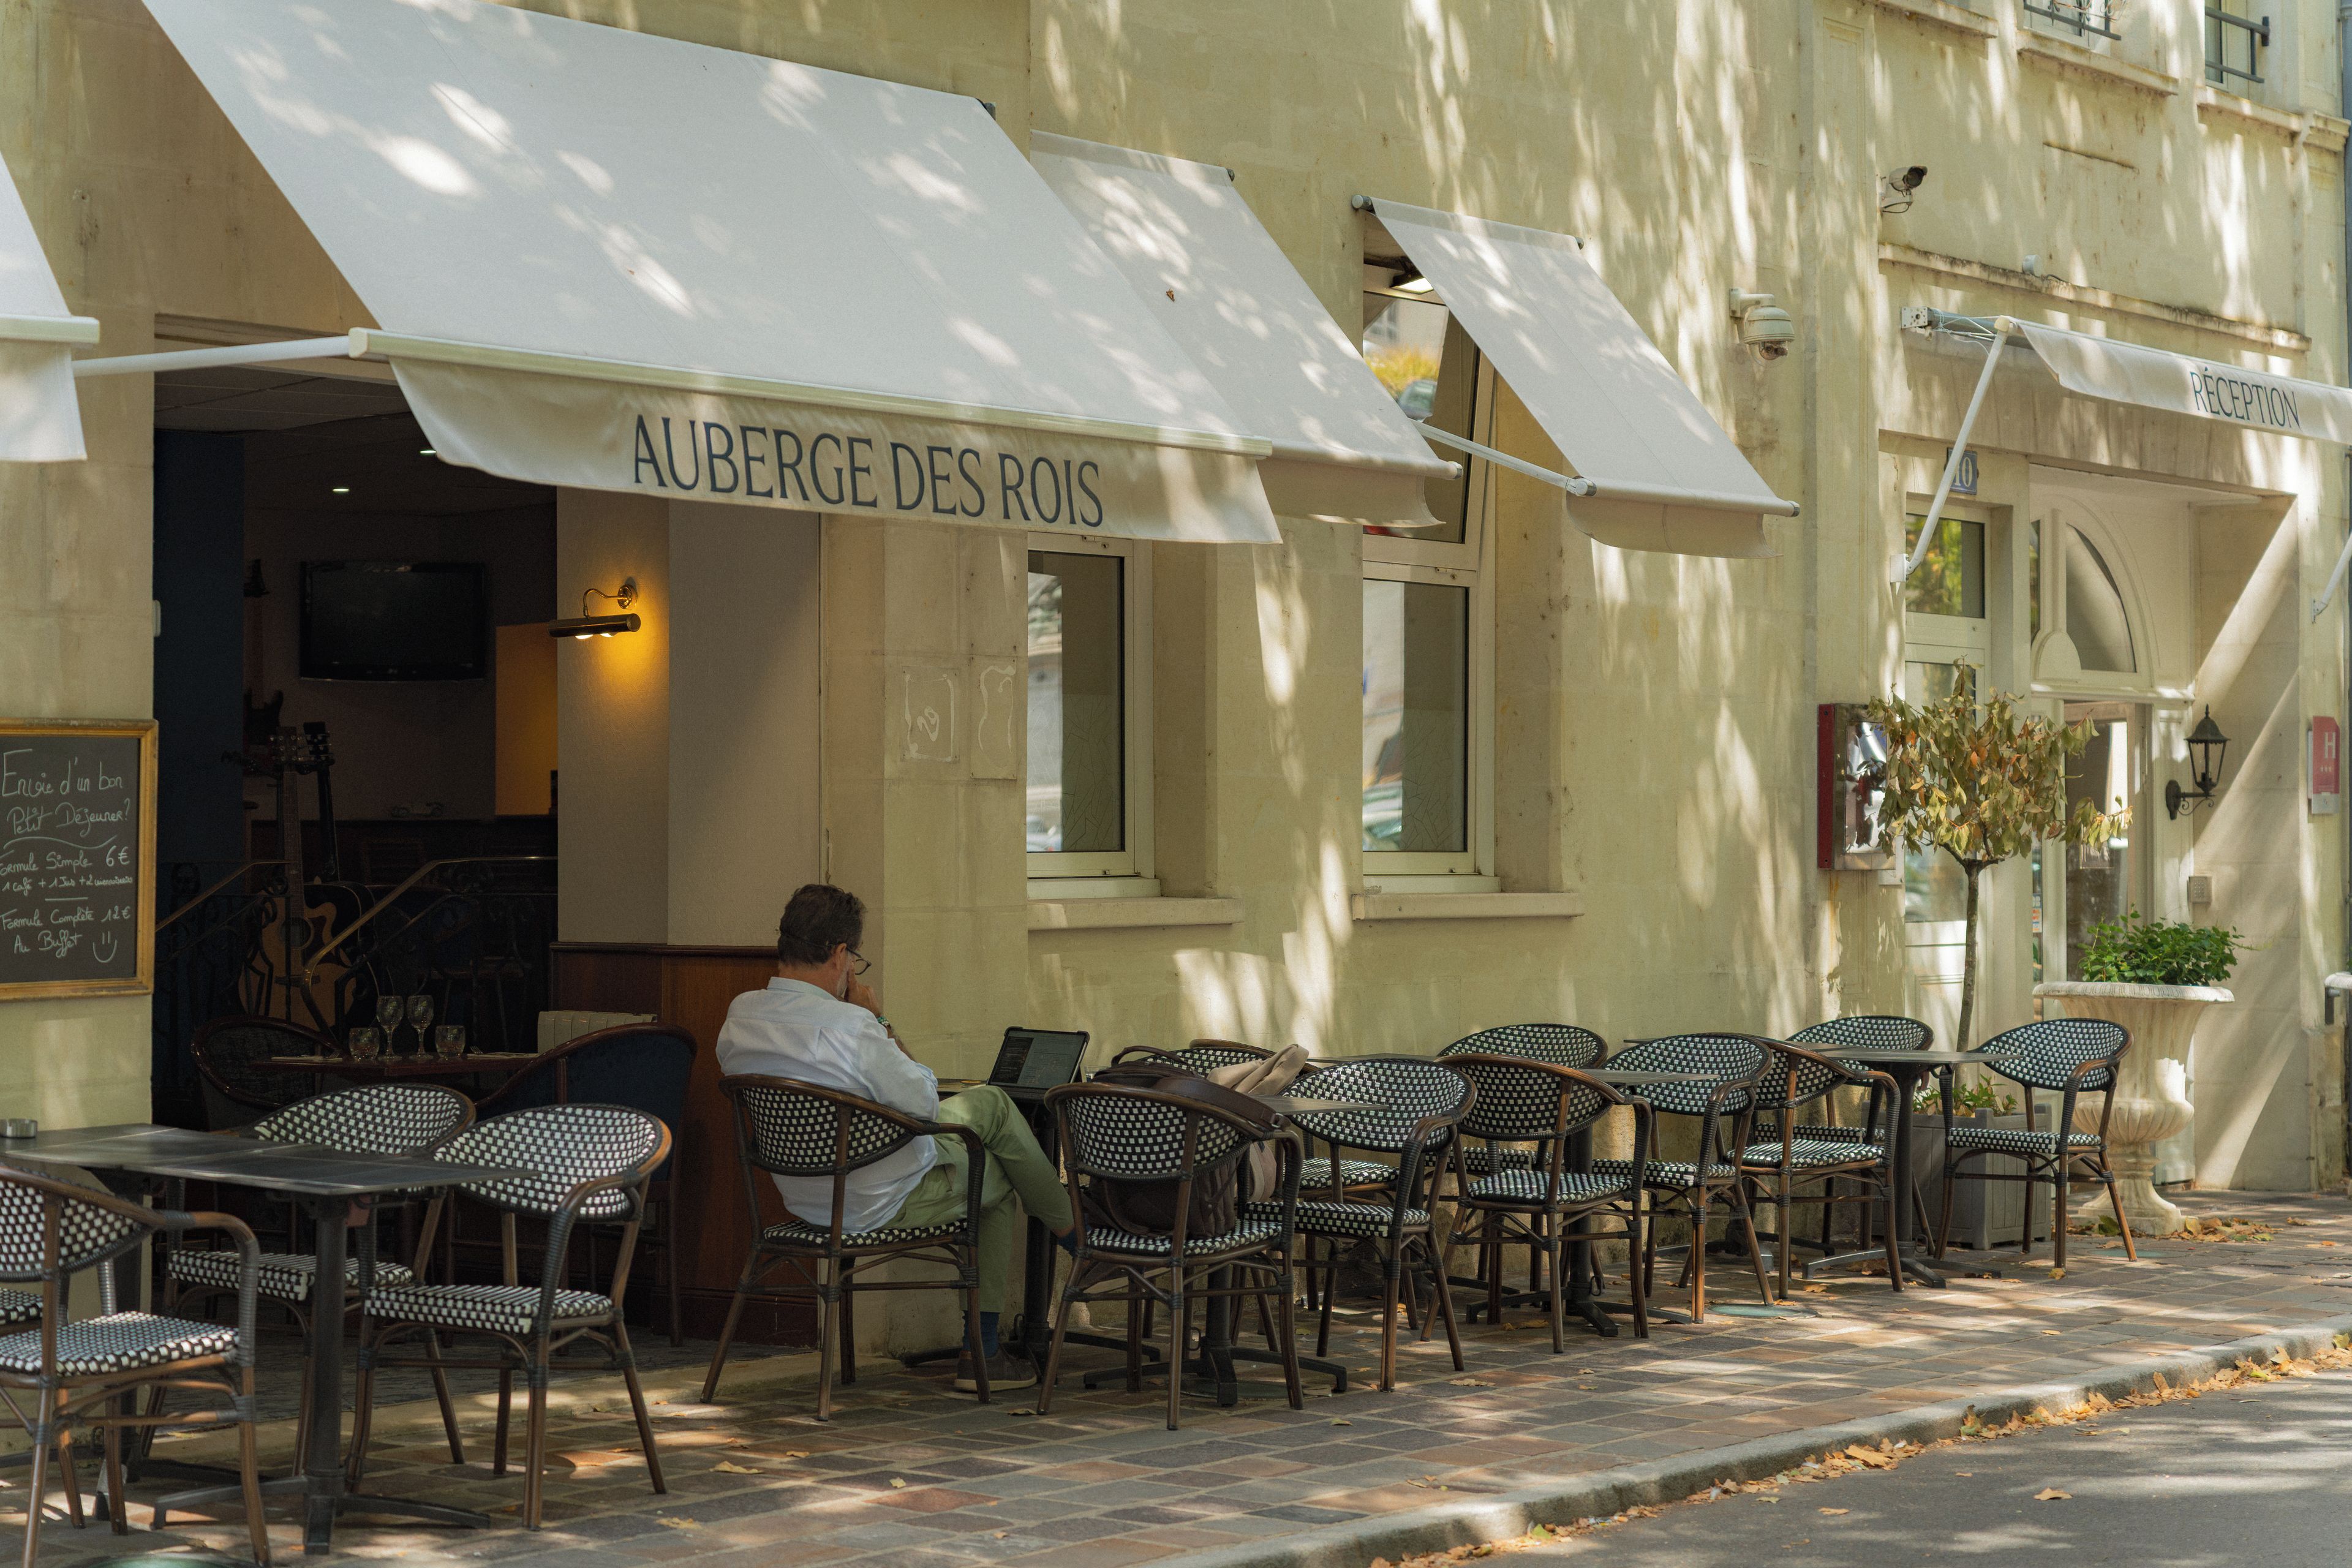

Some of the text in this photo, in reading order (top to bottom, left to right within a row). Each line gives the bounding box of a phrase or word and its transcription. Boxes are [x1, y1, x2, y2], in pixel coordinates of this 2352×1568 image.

[2190, 366, 2302, 430] RÉCEPTION
[633, 414, 1104, 528] AUBERGE DES ROIS
[2324, 731, 2336, 759] H
[2, 748, 123, 797] Envie d'un bon
[7, 805, 53, 835] Petit
[45, 850, 92, 874] Simple
[50, 907, 95, 928] Complète
[13, 929, 83, 959] Au Buffet
